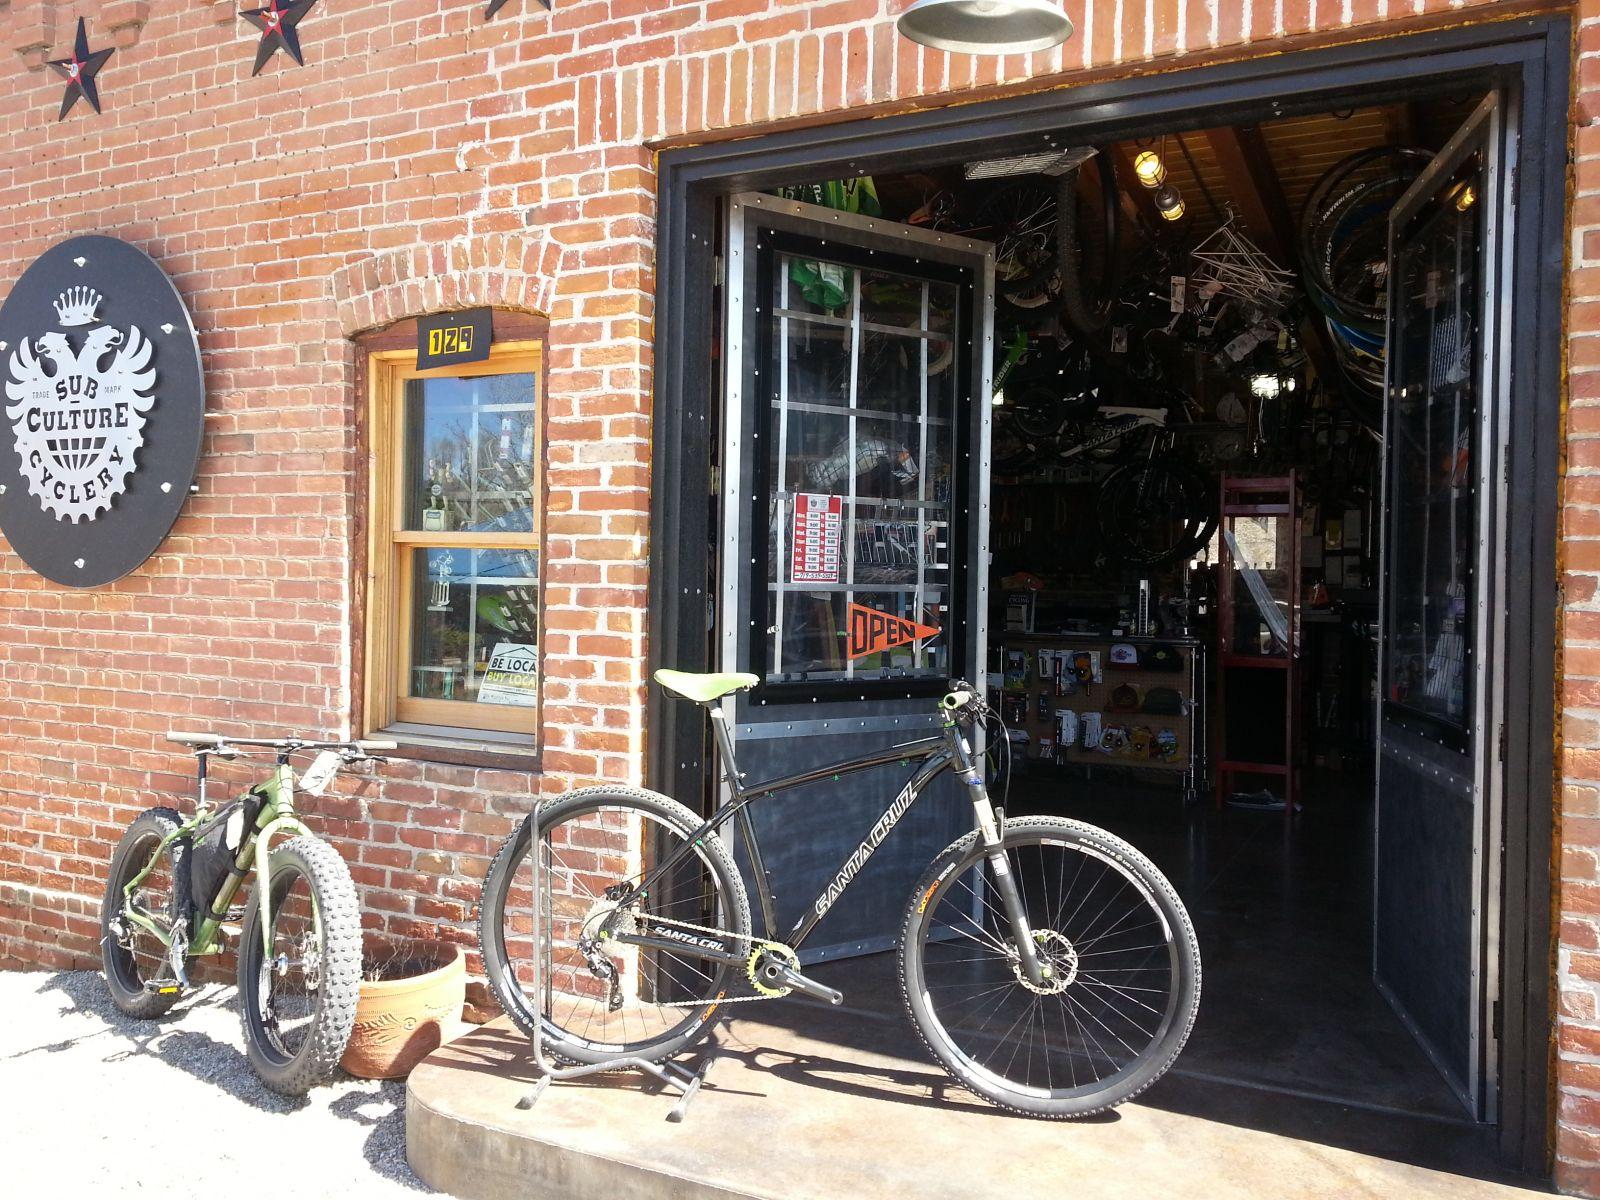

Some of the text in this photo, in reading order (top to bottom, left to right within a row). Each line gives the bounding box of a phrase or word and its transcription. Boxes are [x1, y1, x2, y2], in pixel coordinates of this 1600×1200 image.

[428, 325, 473, 356] 129
[55, 375, 99, 402] SUB
[26, 402, 129, 432] CULTURE
[29, 445, 125, 504] CYCLERY
[852, 608, 916, 655] OPEN
[487, 672, 536, 686] BUY LOCA
[492, 658, 536, 672] BE LOCA
[815, 781, 918, 920] SANTA CRUZ
[1078, 837, 1116, 857] MAXXIS
[654, 926, 698, 945] SANTA
